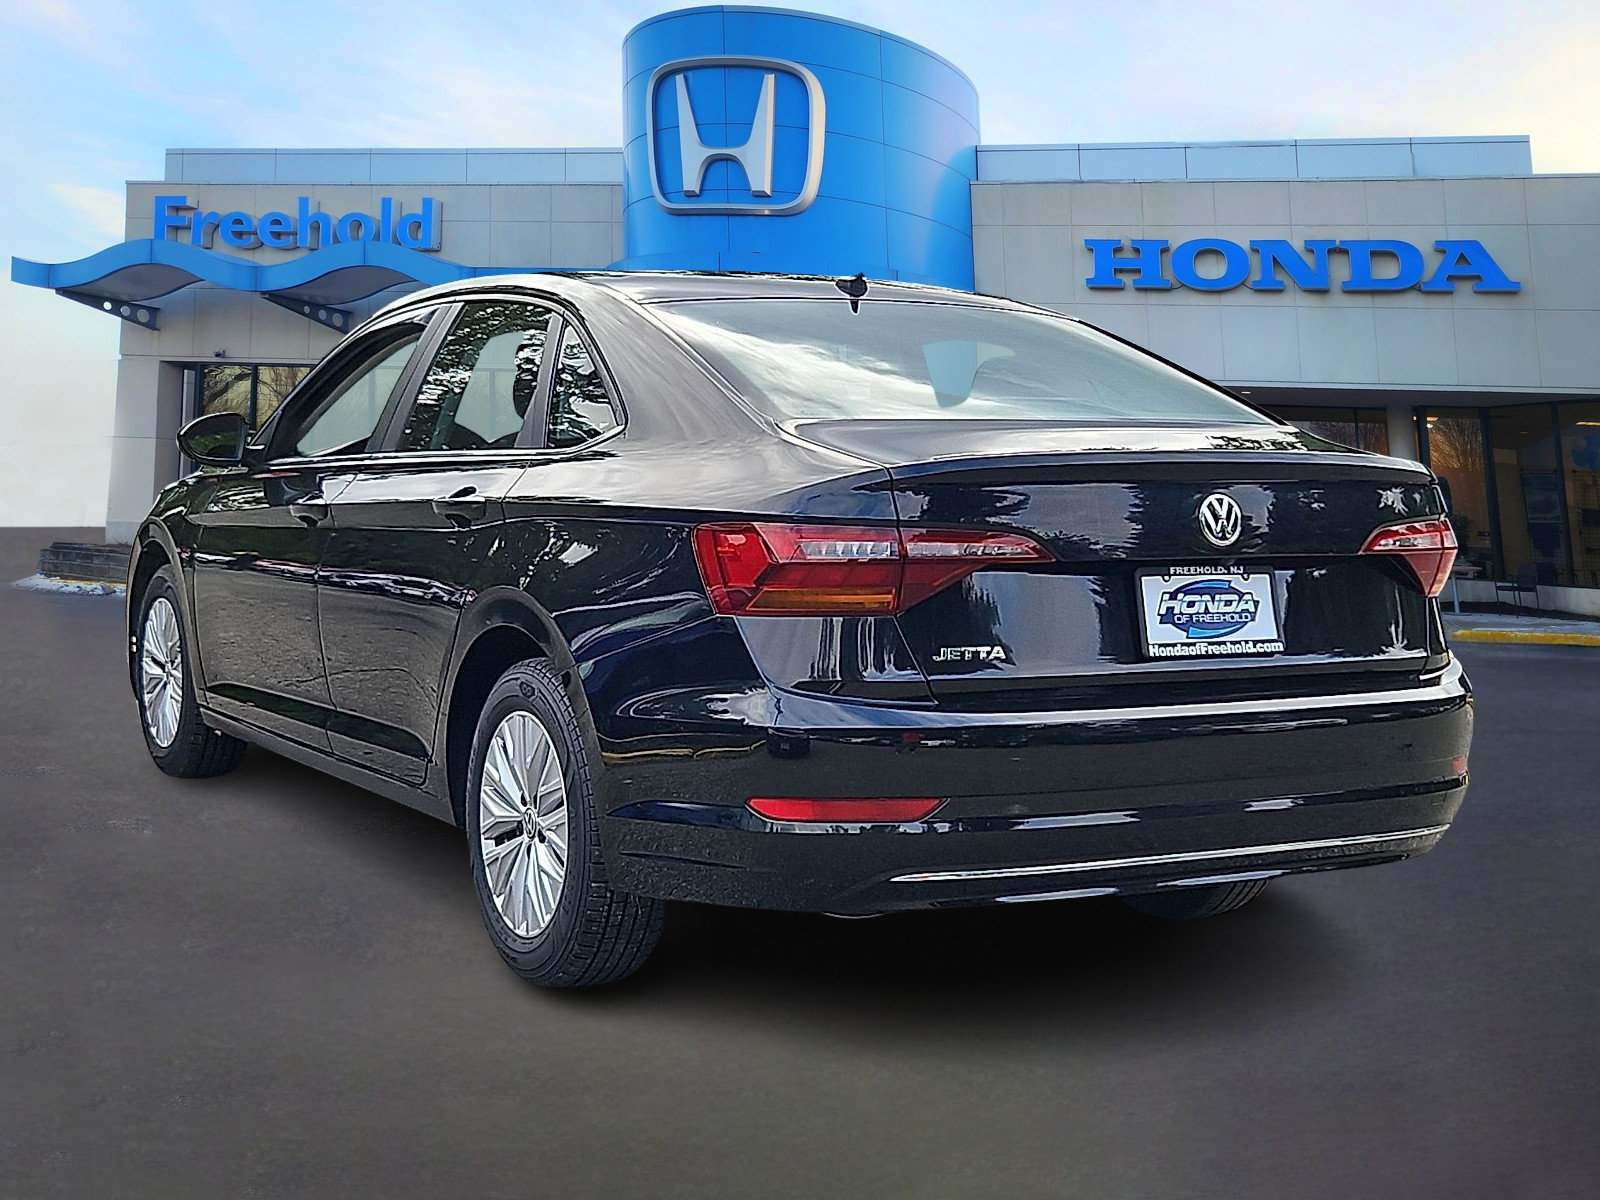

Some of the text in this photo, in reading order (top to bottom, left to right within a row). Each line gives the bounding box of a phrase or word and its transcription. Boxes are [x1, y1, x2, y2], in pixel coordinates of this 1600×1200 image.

[154, 195, 434, 248] Freehold
[1084, 238, 1521, 292] HONDA
[1230, 566, 1244, 574] NJ
[1159, 592, 1255, 614] HONDA
[1173, 613, 1251, 624] OF FREEHOLD
[932, 646, 1007, 662] JETTA
[1149, 641, 1285, 657] HondaofFreehold.com
